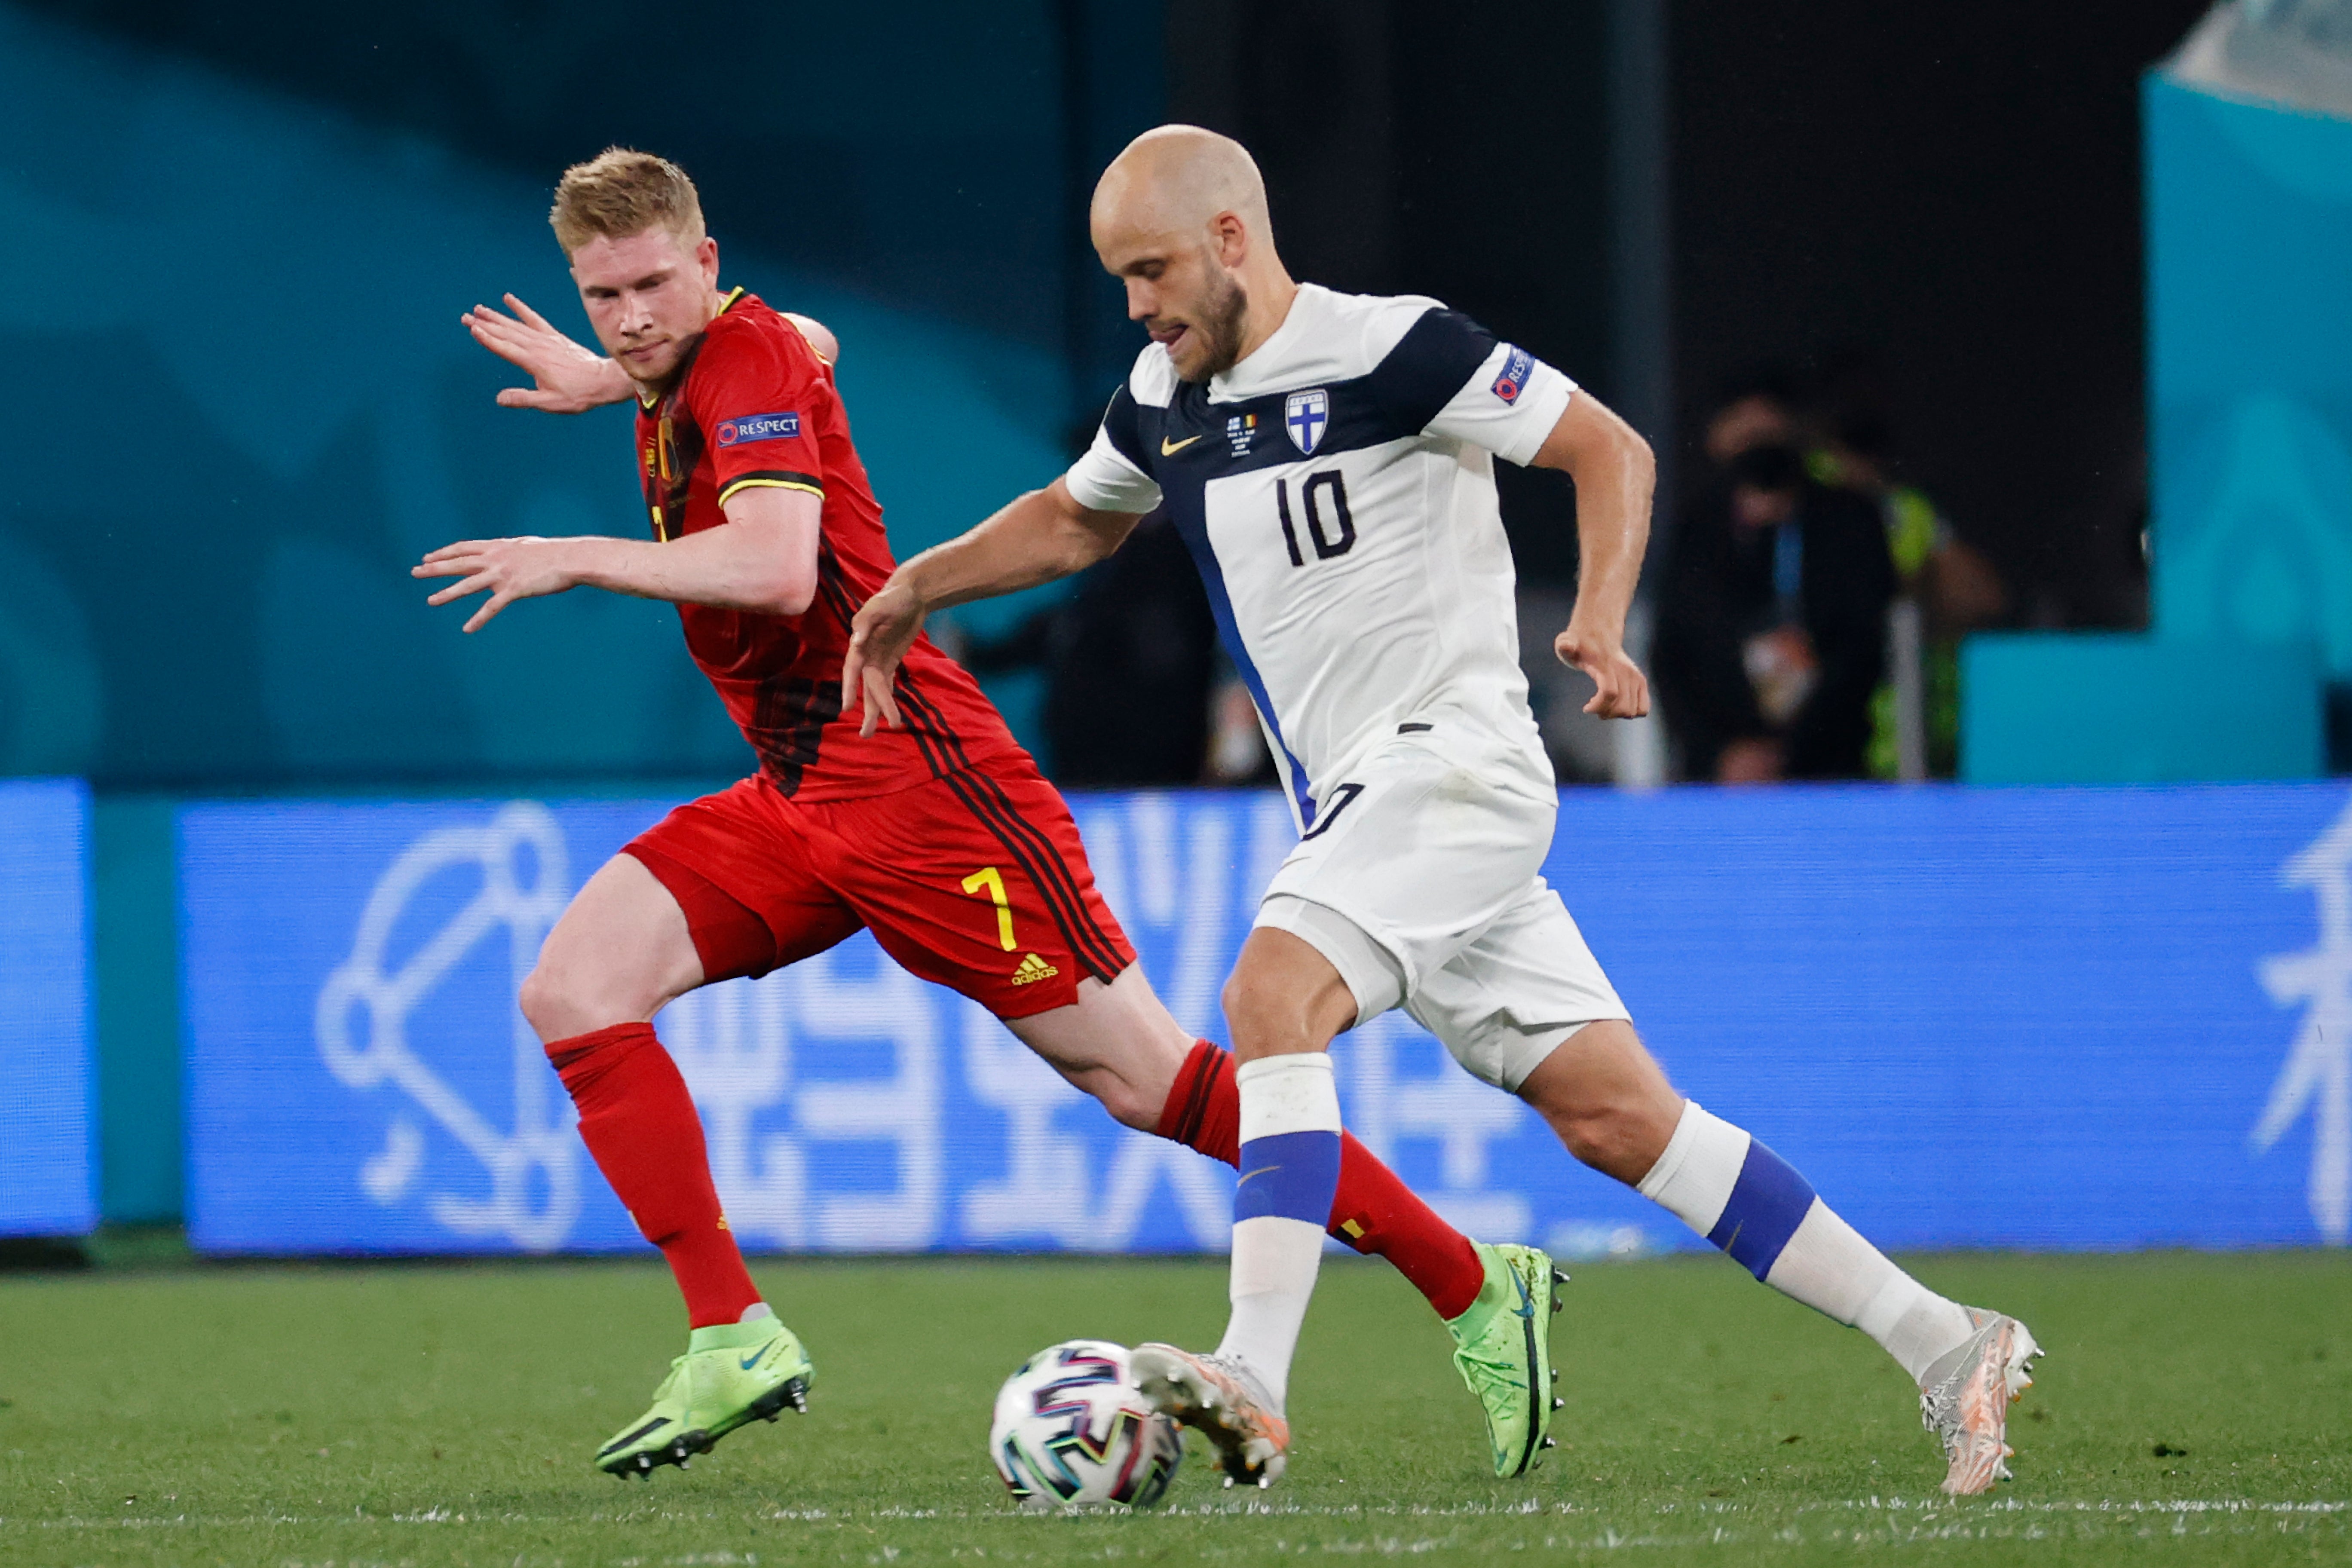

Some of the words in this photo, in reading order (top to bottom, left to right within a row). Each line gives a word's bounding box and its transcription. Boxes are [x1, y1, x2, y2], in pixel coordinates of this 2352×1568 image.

[739, 419, 798, 436] RESPECT
[1277, 469, 1357, 567] 10
[961, 867, 1017, 952] 7
[1011, 965, 1059, 986] adidas
